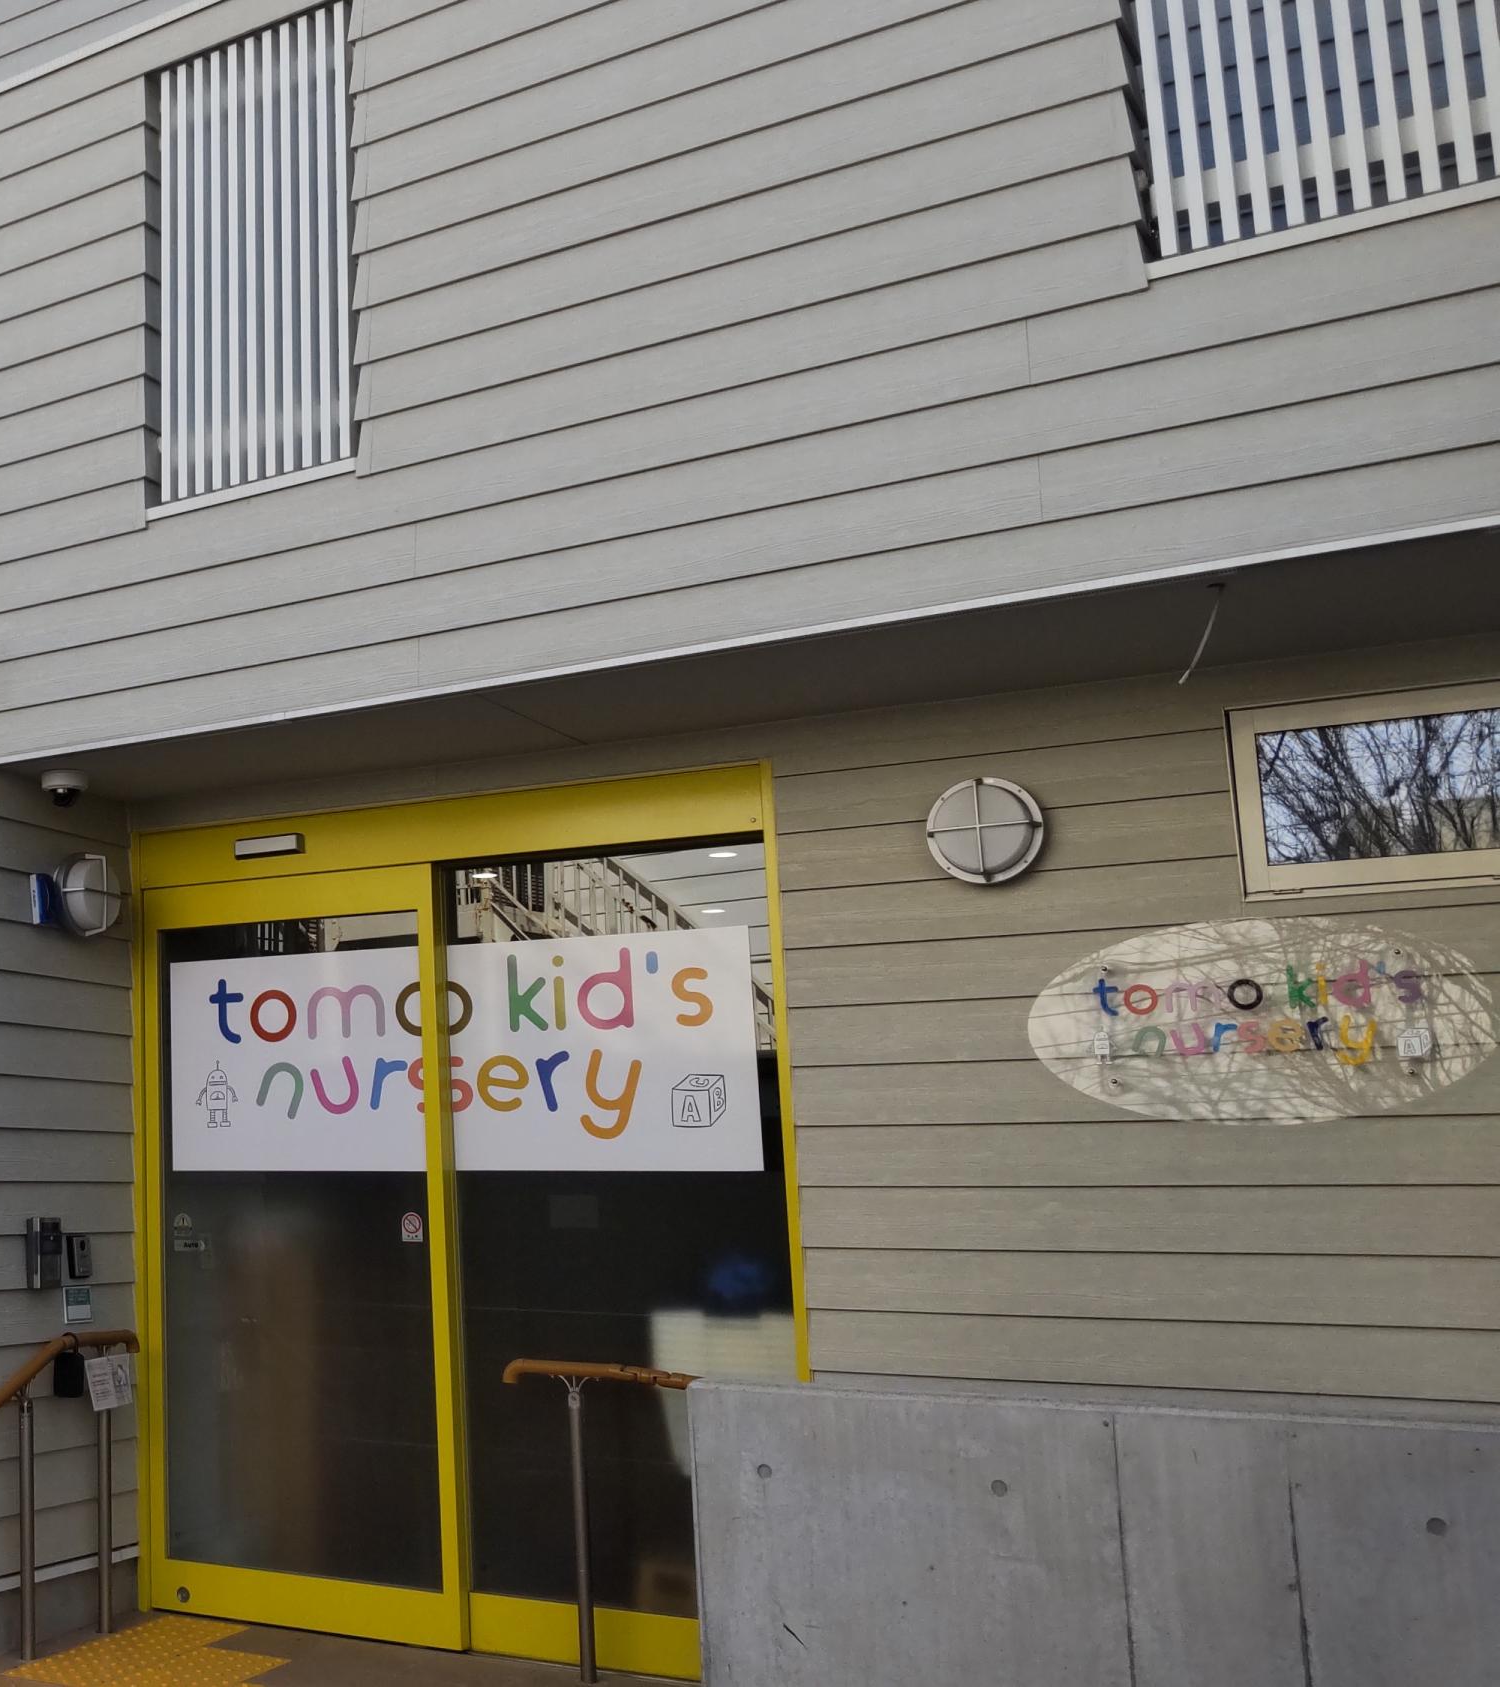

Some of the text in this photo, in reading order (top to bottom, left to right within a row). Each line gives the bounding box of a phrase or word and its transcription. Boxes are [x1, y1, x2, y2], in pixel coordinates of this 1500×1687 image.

[209, 947, 713, 1044] tomo kid's
[1093, 959, 1421, 1016] tomo kid's
[1132, 1014, 1377, 1066] nursery
[256, 1048, 642, 1140] nursery
[681, 1095, 702, 1123] A
